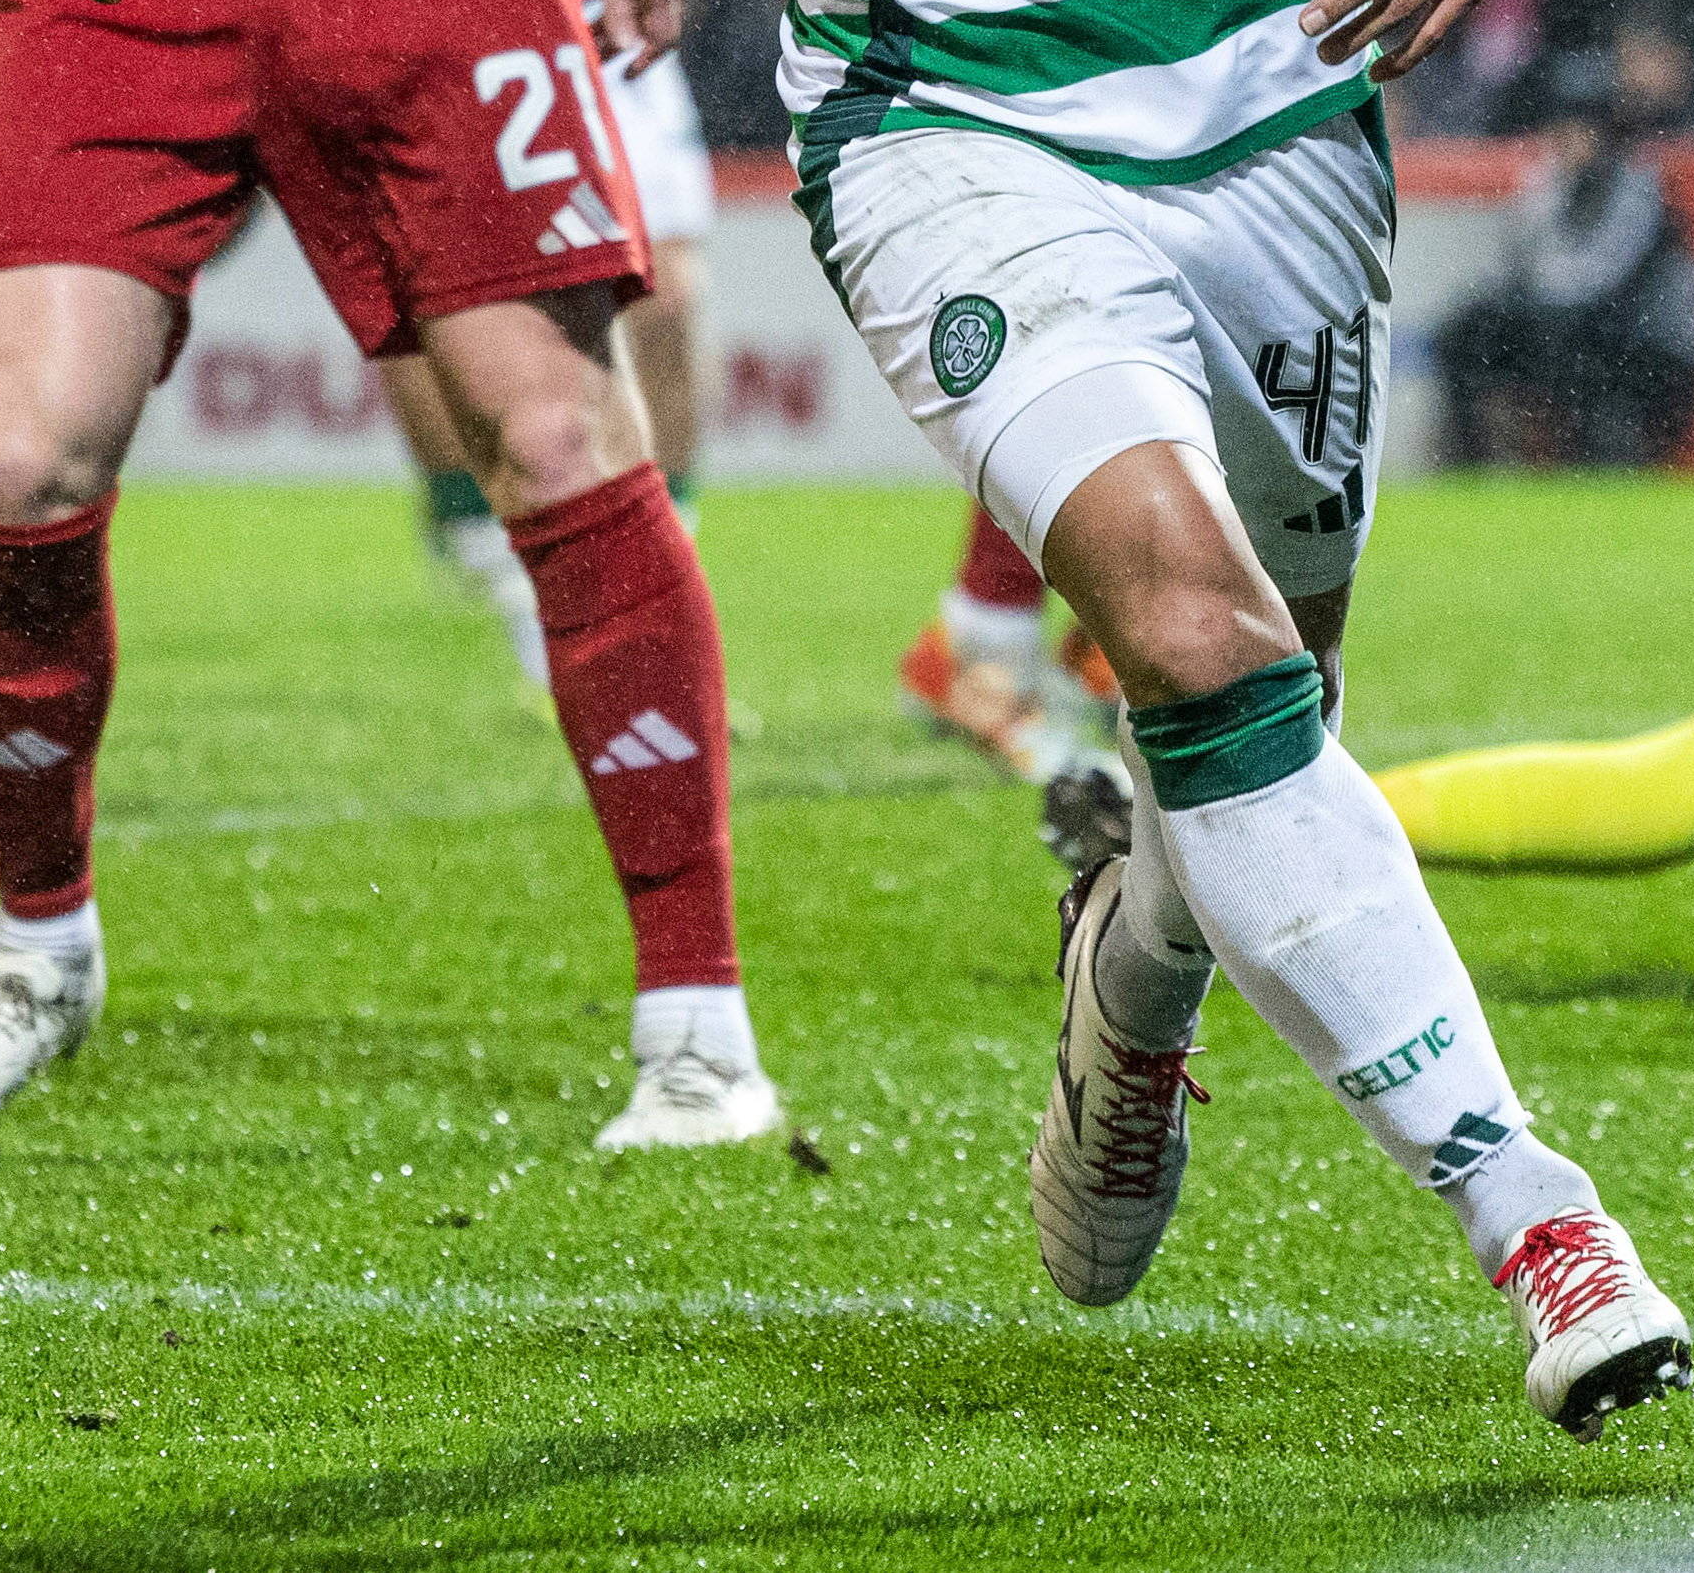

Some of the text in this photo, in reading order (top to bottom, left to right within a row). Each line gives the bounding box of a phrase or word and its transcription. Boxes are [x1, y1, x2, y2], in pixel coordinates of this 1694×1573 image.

[473, 43, 615, 193] 21
[1255, 305, 1374, 465] 41
[1337, 1016, 1455, 1101] CELTIC
